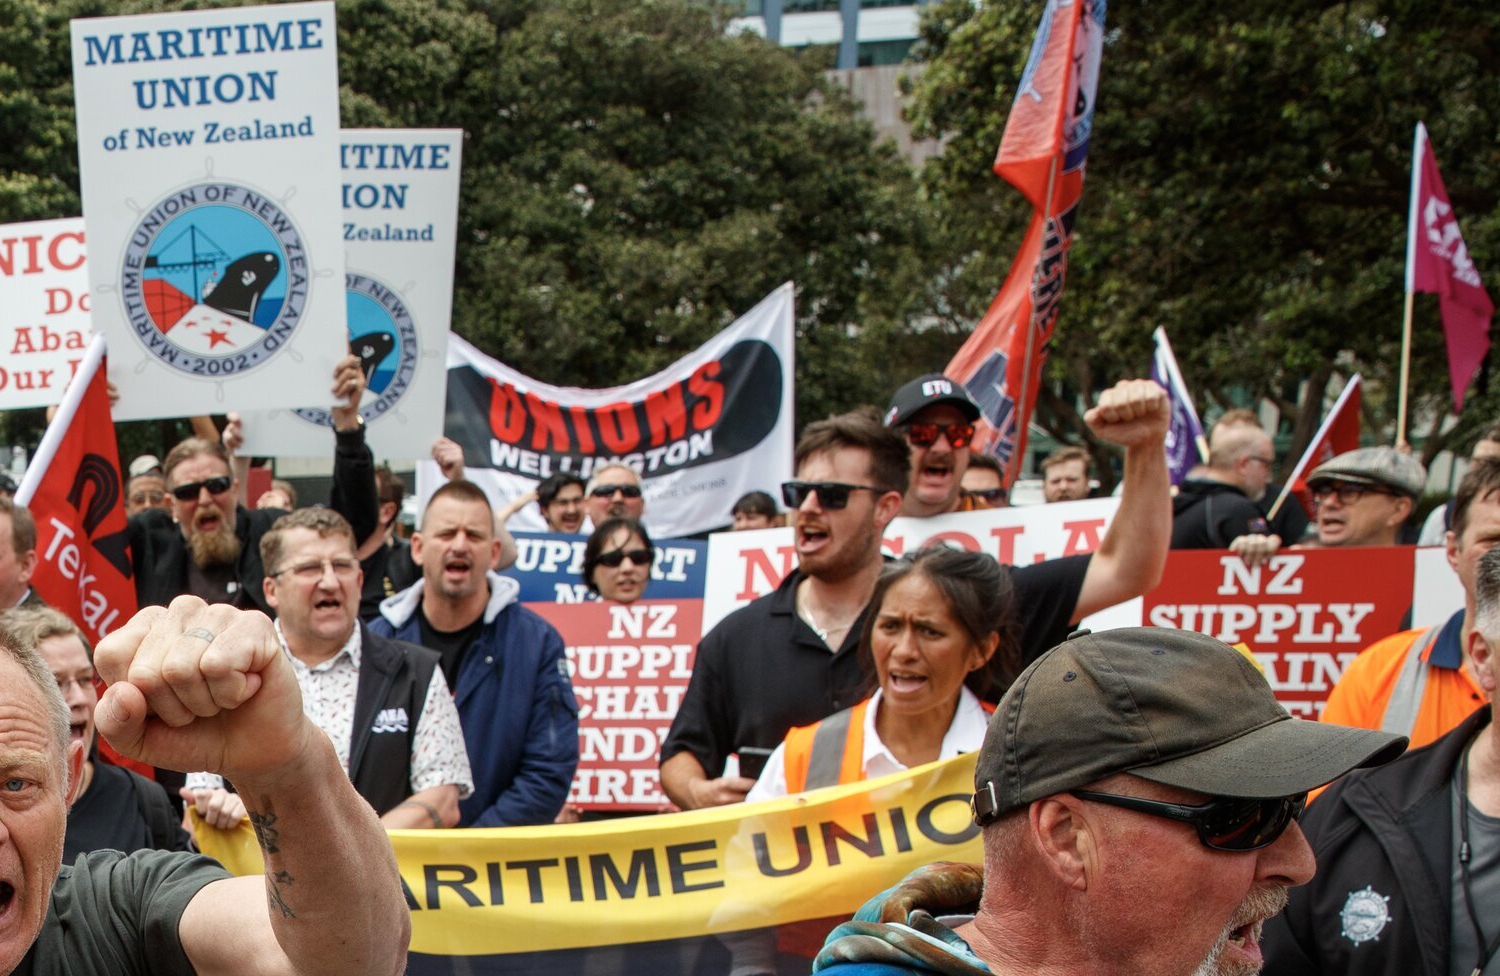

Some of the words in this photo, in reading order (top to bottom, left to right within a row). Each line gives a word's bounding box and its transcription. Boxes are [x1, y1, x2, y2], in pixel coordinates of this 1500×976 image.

[84, 20, 323, 66] MARITIME
[133, 71, 278, 111] UNION
[103, 130, 131, 151] of
[137, 126, 194, 149] New
[205, 116, 314, 145] Zealand
[204, 186, 238, 201] OF
[243, 193, 292, 234] NEW
[134, 189, 197, 248] UNION
[342, 222, 435, 242] Zealand
[123, 255, 179, 364] MARITIME
[263, 238, 308, 353] ZEALAND
[368, 284, 408, 319] NEW
[192, 355, 250, 375] 2002
[374, 322, 417, 413] ZEALAND
[486, 360, 725, 455] UNIONS
[1217, 555, 1306, 595] NZ
[607, 605, 678, 639] NZ
[1150, 603, 1375, 643] SUPPLY
